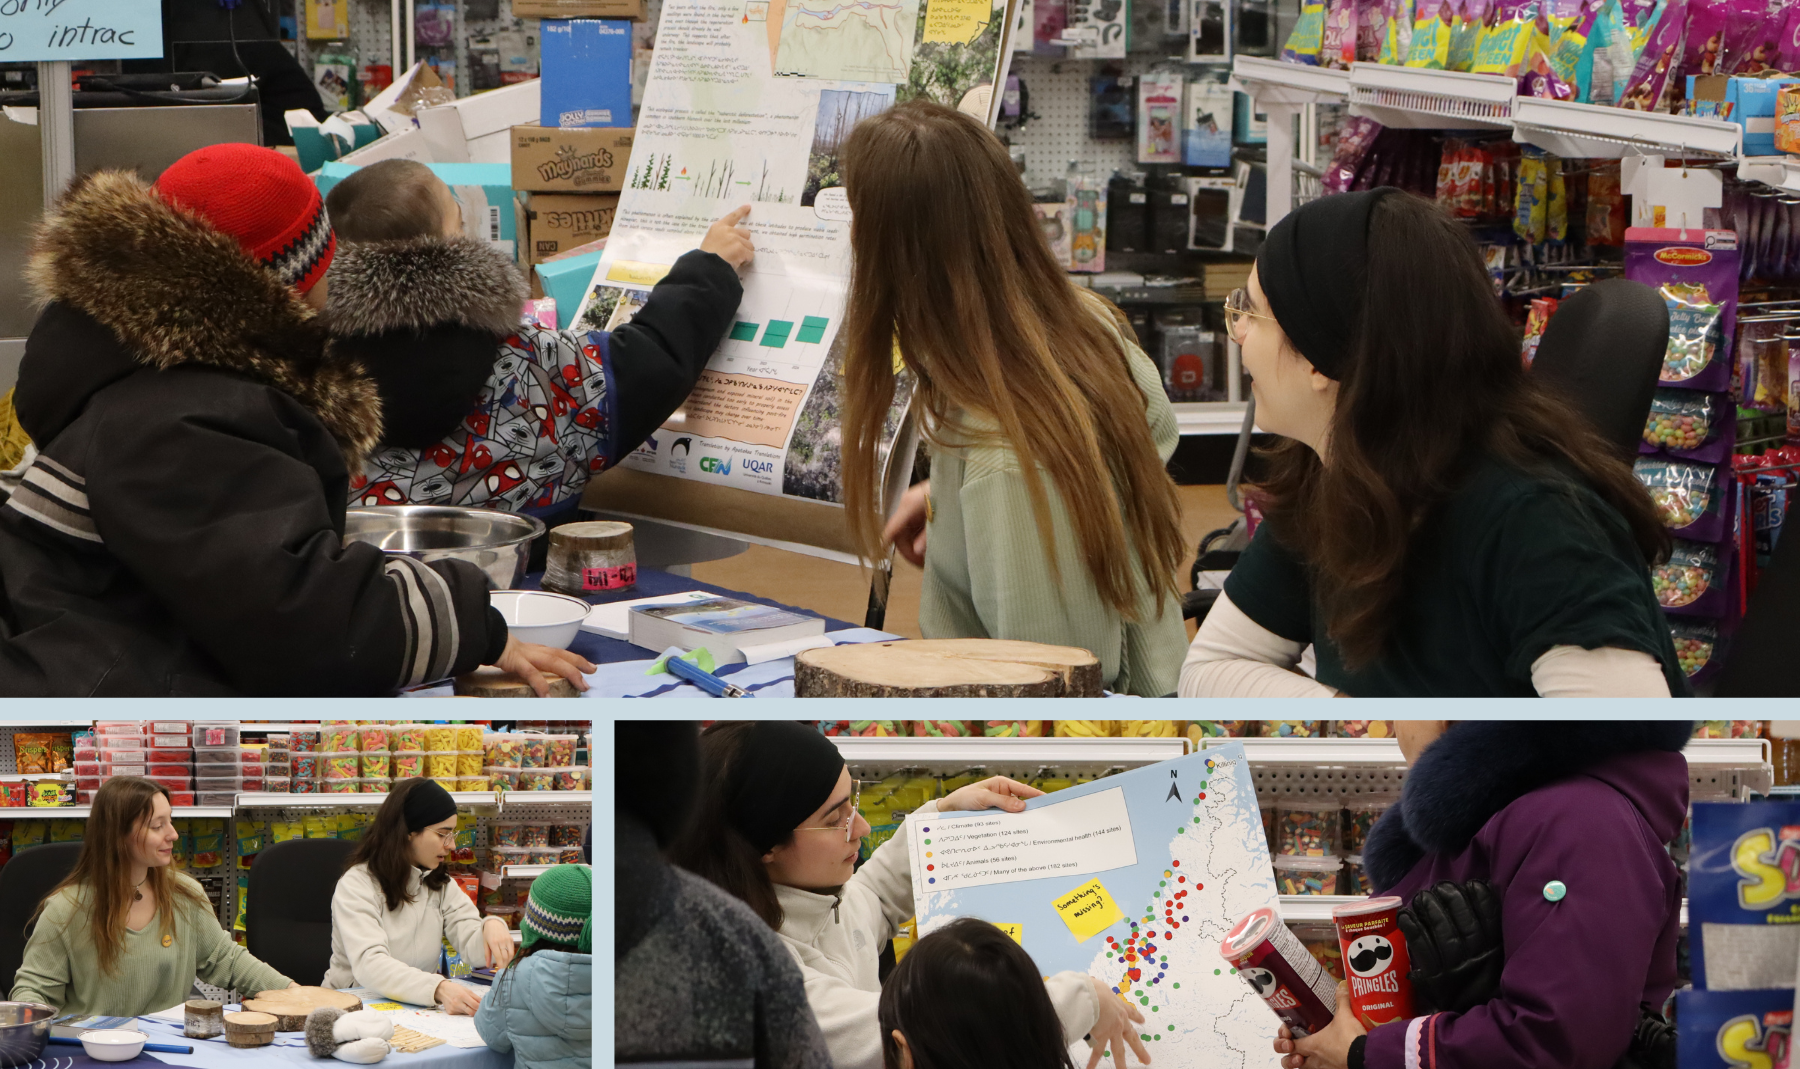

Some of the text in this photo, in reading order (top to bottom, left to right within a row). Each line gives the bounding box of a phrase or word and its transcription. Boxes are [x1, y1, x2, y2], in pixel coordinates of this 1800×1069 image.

[1743, 83, 1753, 93] 36
[537, 148, 614, 182] Maynards
[540, 241, 556, 250] CAN
[1660, 252, 1707, 260] McCormicks
[1670, 312, 1690, 323] Jelly
[742, 458, 773, 473] UQAR
[1171, 770, 1177, 778] N
[966, 832, 997, 840] Vegetation
[1033, 836, 1073, 846] Environmental
[1074, 832, 1091, 840] health
[1092, 829, 1105, 837] (144
[1106, 825, 1122, 834] sites)
[1057, 884, 1100, 910] Something's
[1074, 896, 1104, 918] missing?
[1364, 918, 1389, 927] PARFAITE
[1351, 970, 1399, 998] PRINGLES
[1362, 1002, 1394, 1011] ORIGINAL
